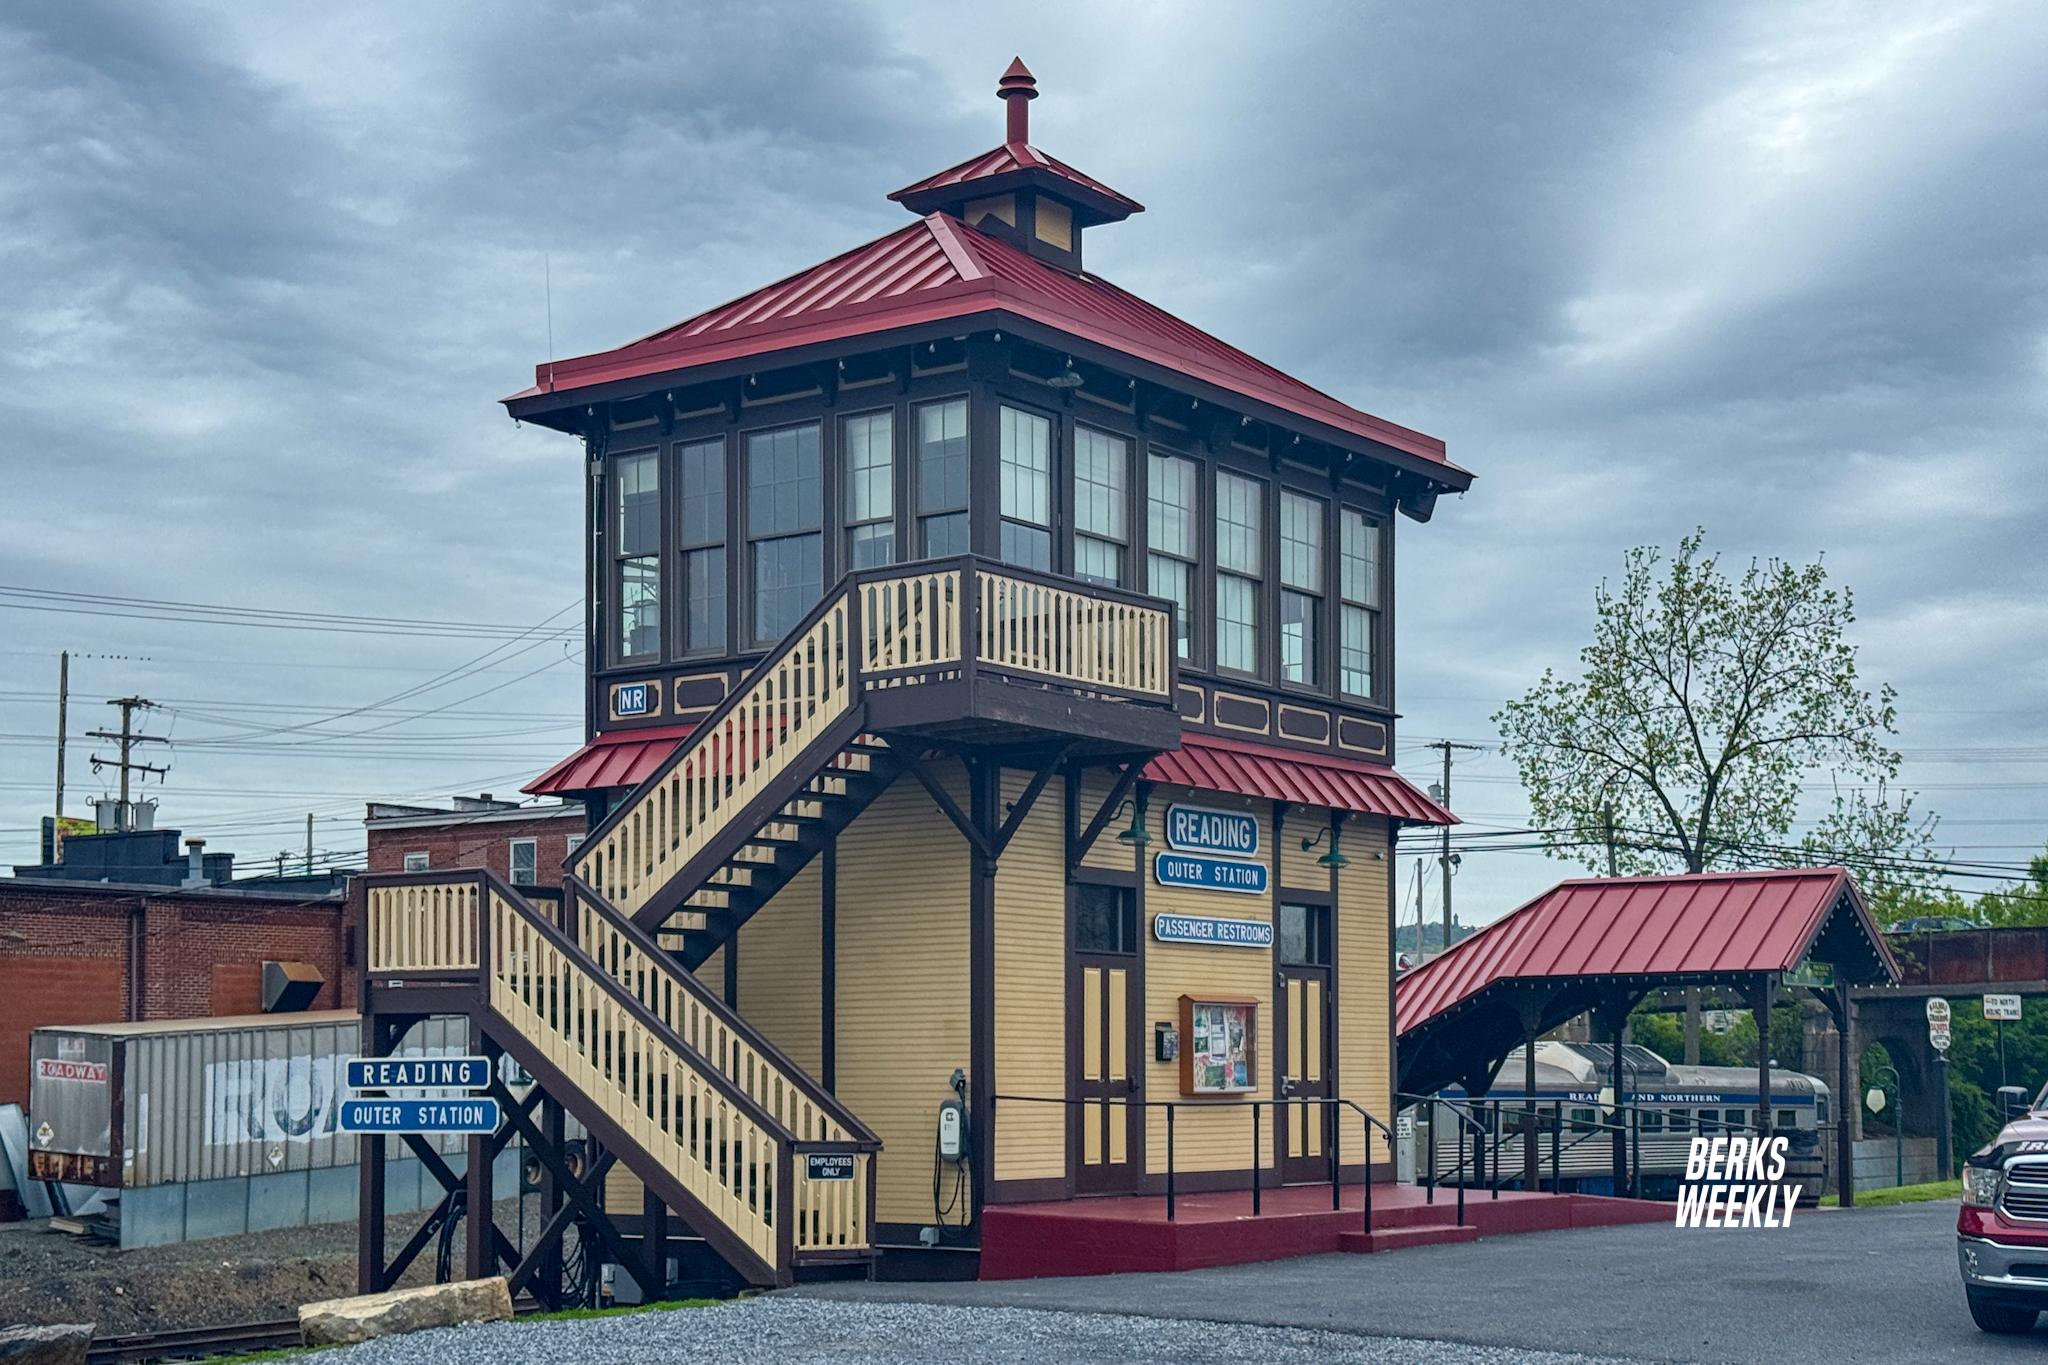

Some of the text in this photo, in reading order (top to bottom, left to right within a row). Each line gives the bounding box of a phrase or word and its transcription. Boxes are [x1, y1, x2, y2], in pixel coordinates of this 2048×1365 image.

[621, 689, 643, 710] NR
[1175, 812, 1251, 849] READING
[1167, 861, 1259, 886] OUTER STATION
[1158, 919, 1271, 942] PASSENGER RESTROOMS
[40, 1062, 105, 1080] ROADWAY
[363, 1063, 471, 1085] READING
[1569, 1092, 1605, 1102] READ
[1660, 1093, 1721, 1103] NORTHERN
[353, 1106, 484, 1125] OUTER STATION
[810, 1156, 853, 1167] EMPLOYEES
[821, 1167, 841, 1177] ONLY
